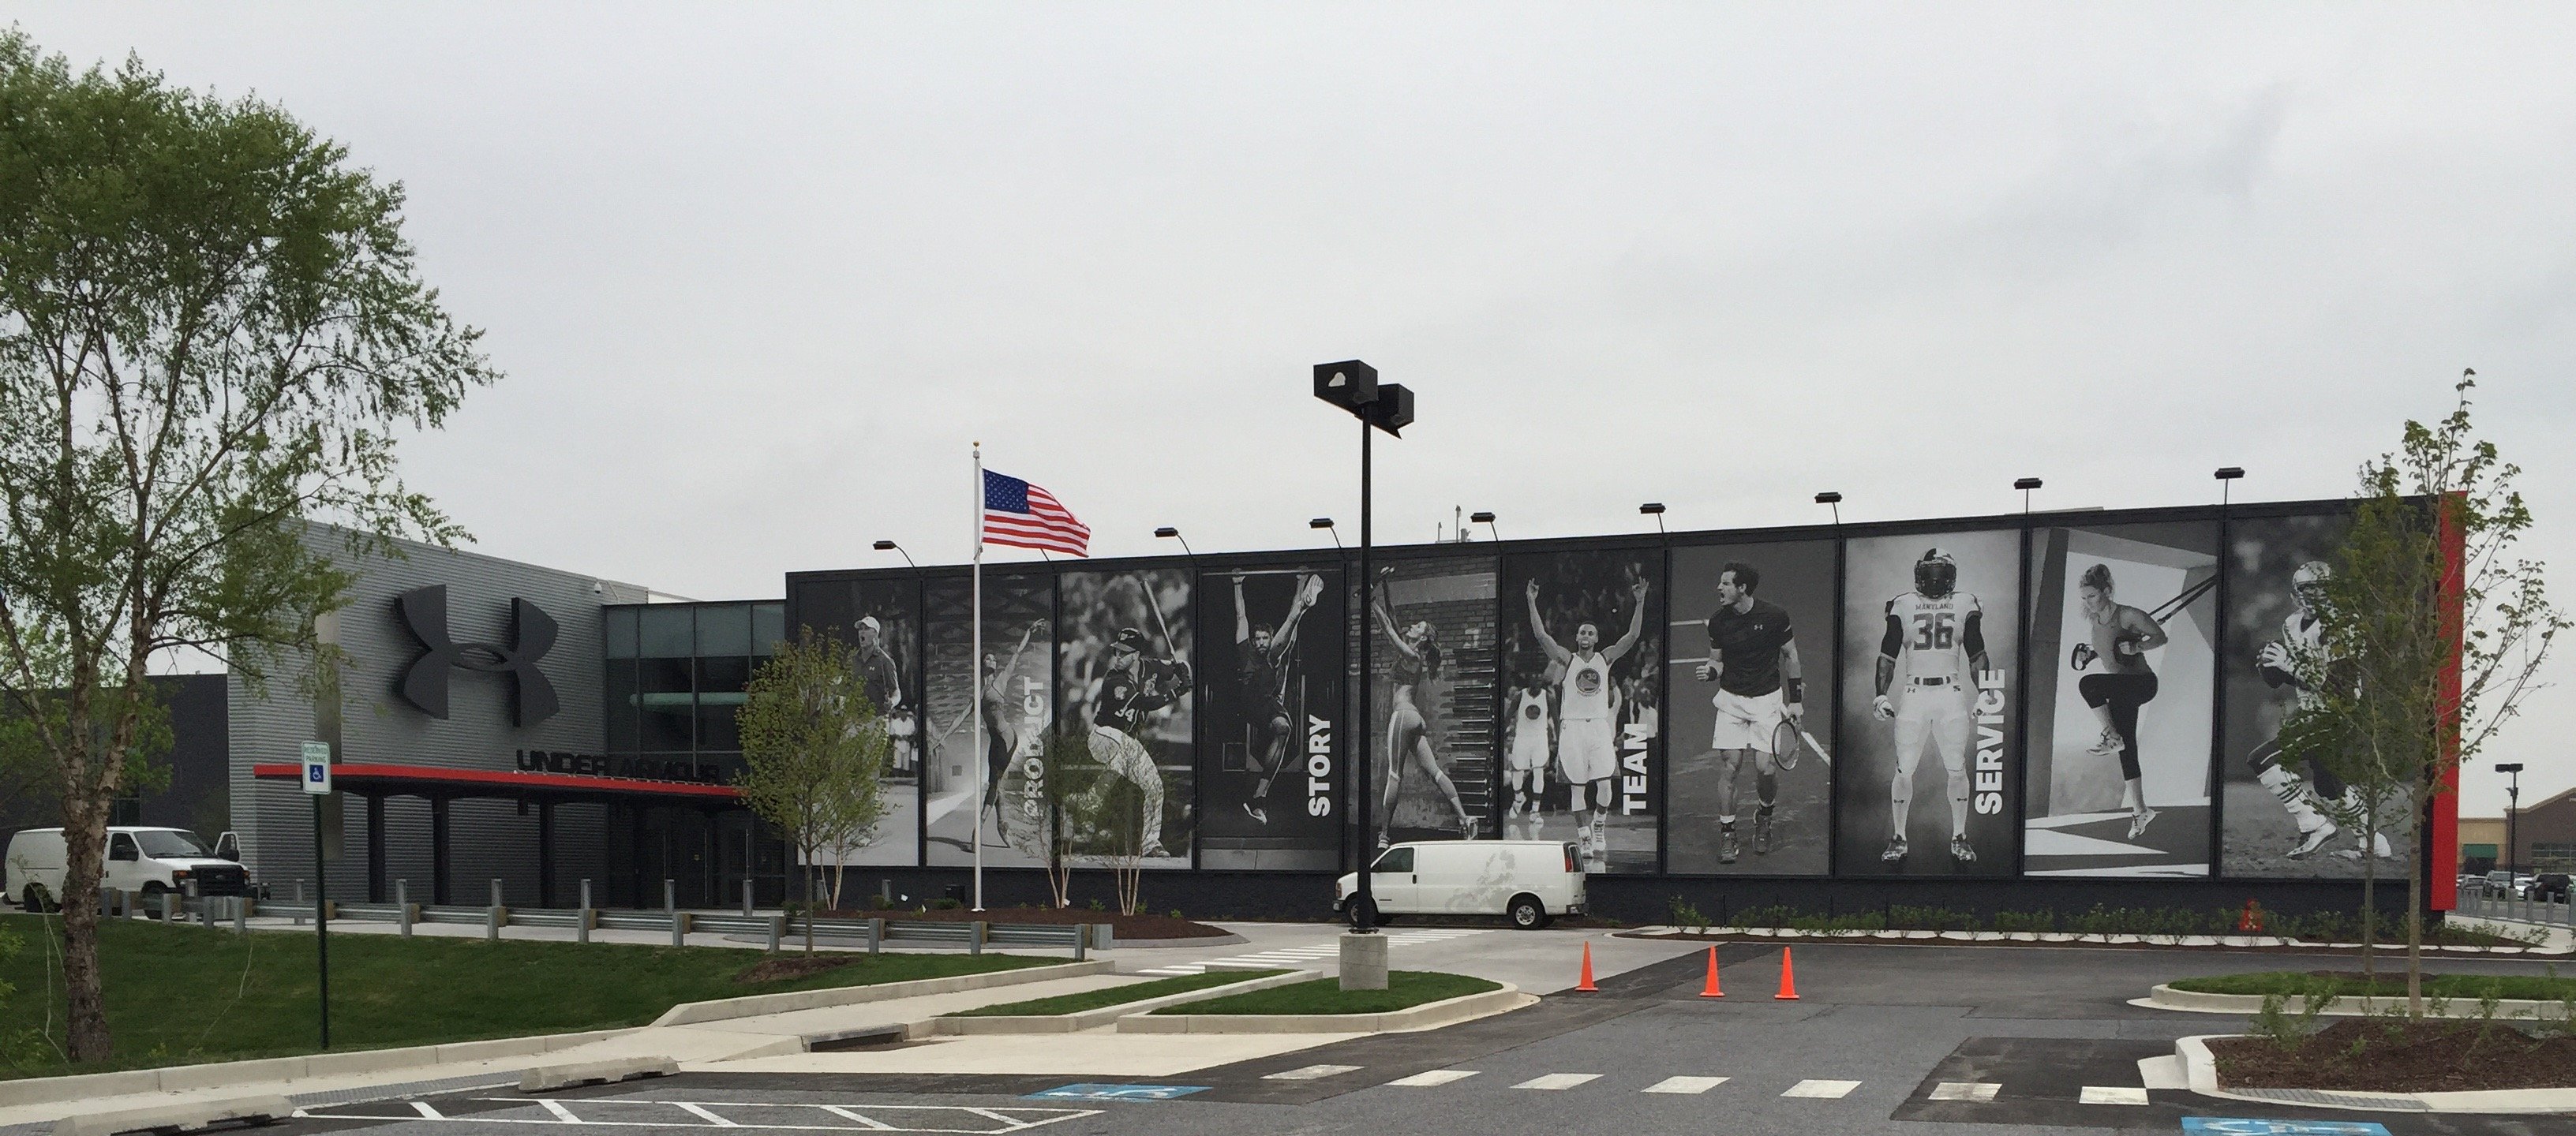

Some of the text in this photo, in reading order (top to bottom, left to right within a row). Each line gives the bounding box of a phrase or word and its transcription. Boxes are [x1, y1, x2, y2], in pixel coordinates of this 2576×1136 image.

[1913, 613, 1955, 650] 36
[1114, 708, 1135, 722] 34
[1975, 669, 2005, 815] SERVICE
[515, 749, 610, 776] UNDER
[1308, 714, 1331, 817] STORY
[1623, 723, 1648, 815] TEAM
